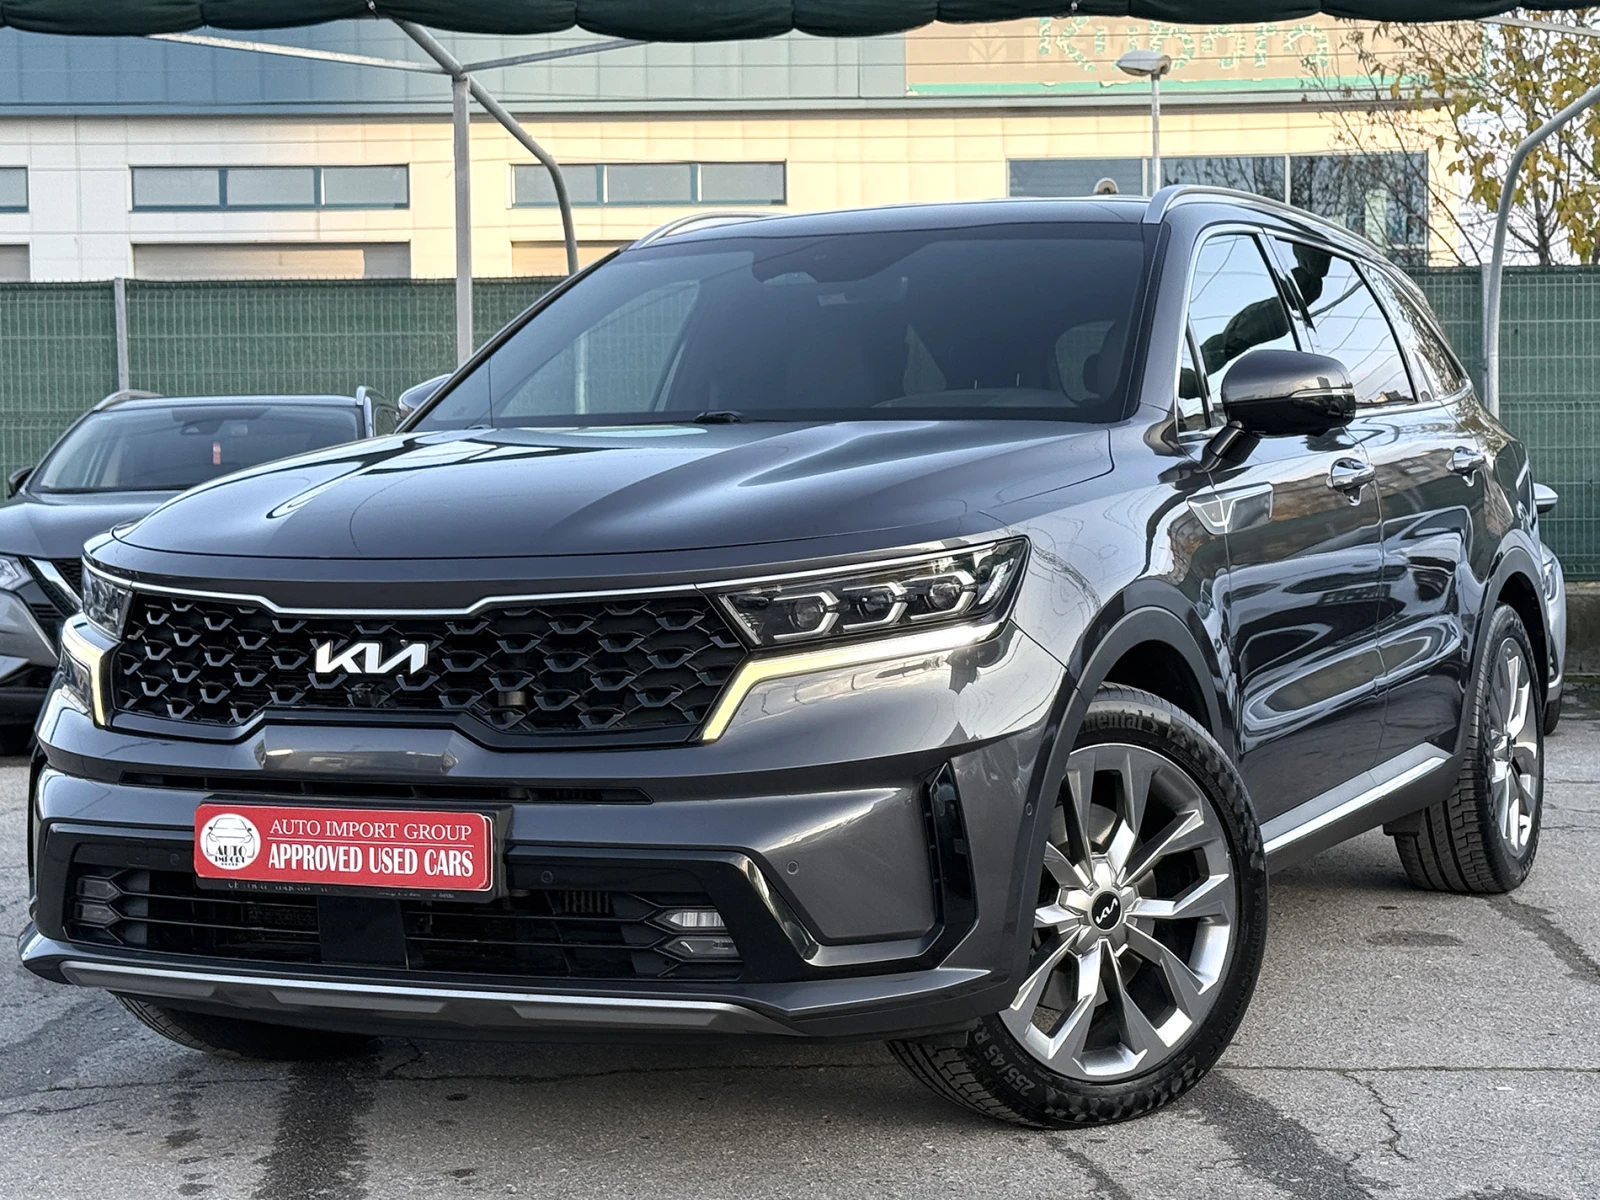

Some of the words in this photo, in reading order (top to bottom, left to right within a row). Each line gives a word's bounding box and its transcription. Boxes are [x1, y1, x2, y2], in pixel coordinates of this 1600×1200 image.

[315, 640, 429, 675] KIA
[1081, 709, 1143, 732] nental
[270, 819, 320, 836] AUTO
[325, 820, 399, 839] IMPORT
[404, 823, 472, 841] GROUP
[216, 845, 247, 857] AUTO
[268, 843, 363, 873] APPROVED
[369, 847, 419, 875] USED
[424, 848, 474, 877] CARS
[982, 1044, 1036, 1097] 255/45
